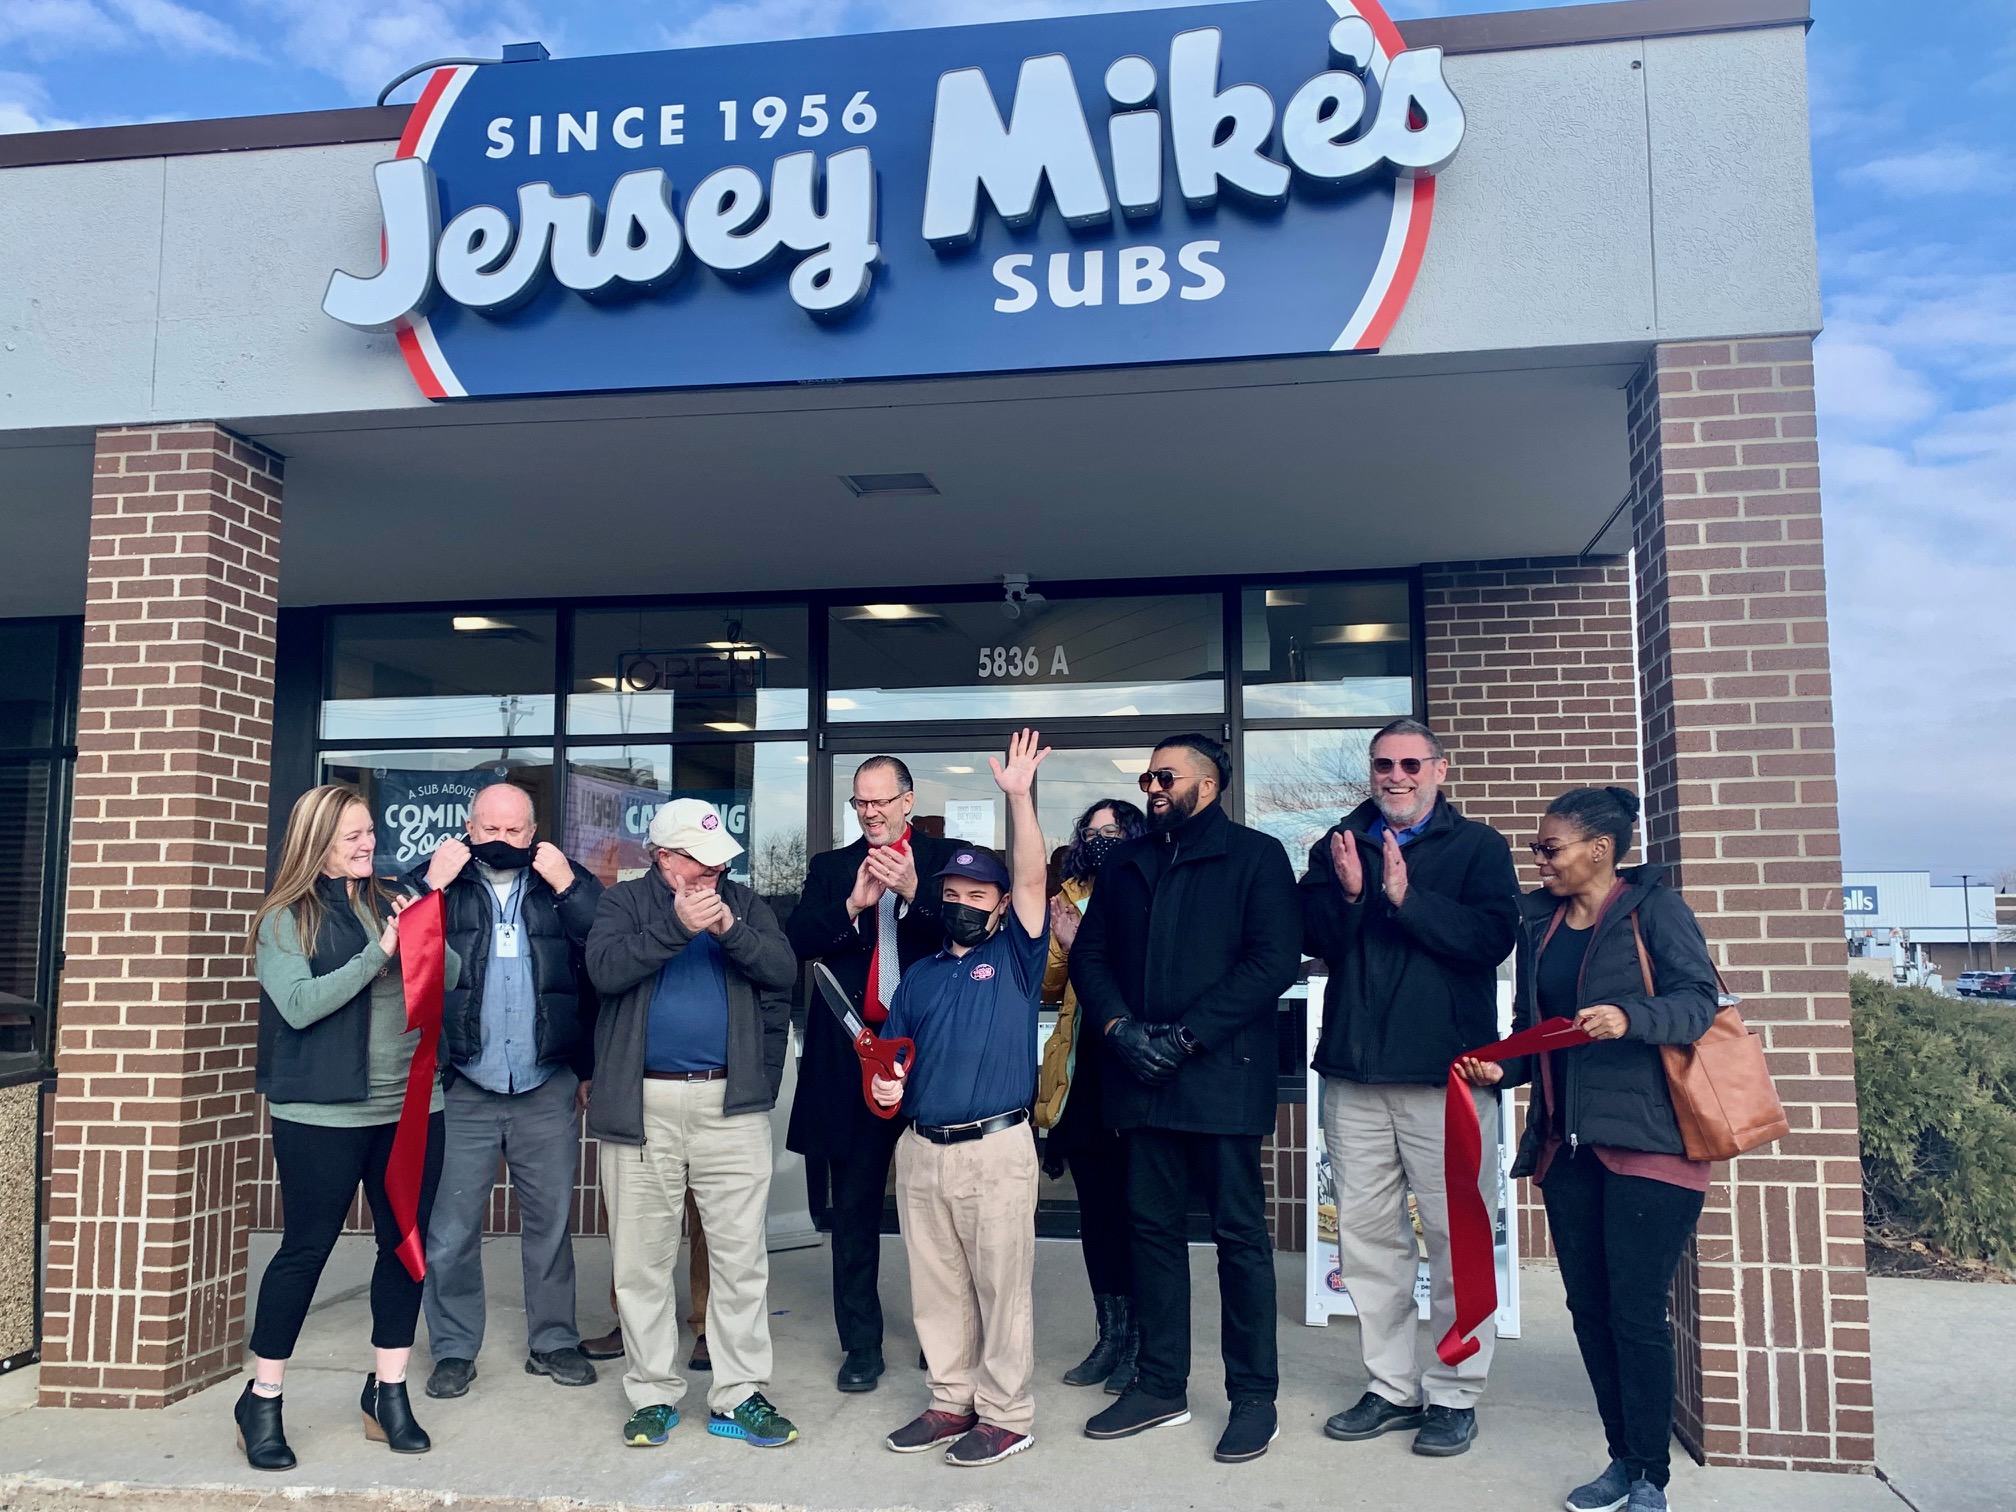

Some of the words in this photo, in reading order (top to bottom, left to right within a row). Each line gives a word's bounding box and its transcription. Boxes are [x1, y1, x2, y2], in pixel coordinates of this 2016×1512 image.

[485, 104, 685, 159] SINCE
[718, 91, 877, 142] 1956
[321, 146, 882, 331] Jersey
[922, 15, 1467, 246] Mike's
[992, 240, 1226, 313] SUBS
[625, 655, 755, 691] OPEN
[978, 646, 1039, 677] 5836
[1050, 645, 1069, 675] A
[408, 789, 416, 799] A
[418, 784, 438, 796] SUB
[441, 783, 476, 798] ABOVE
[385, 804, 472, 828] COMIN
[625, 804, 746, 834] CANG
